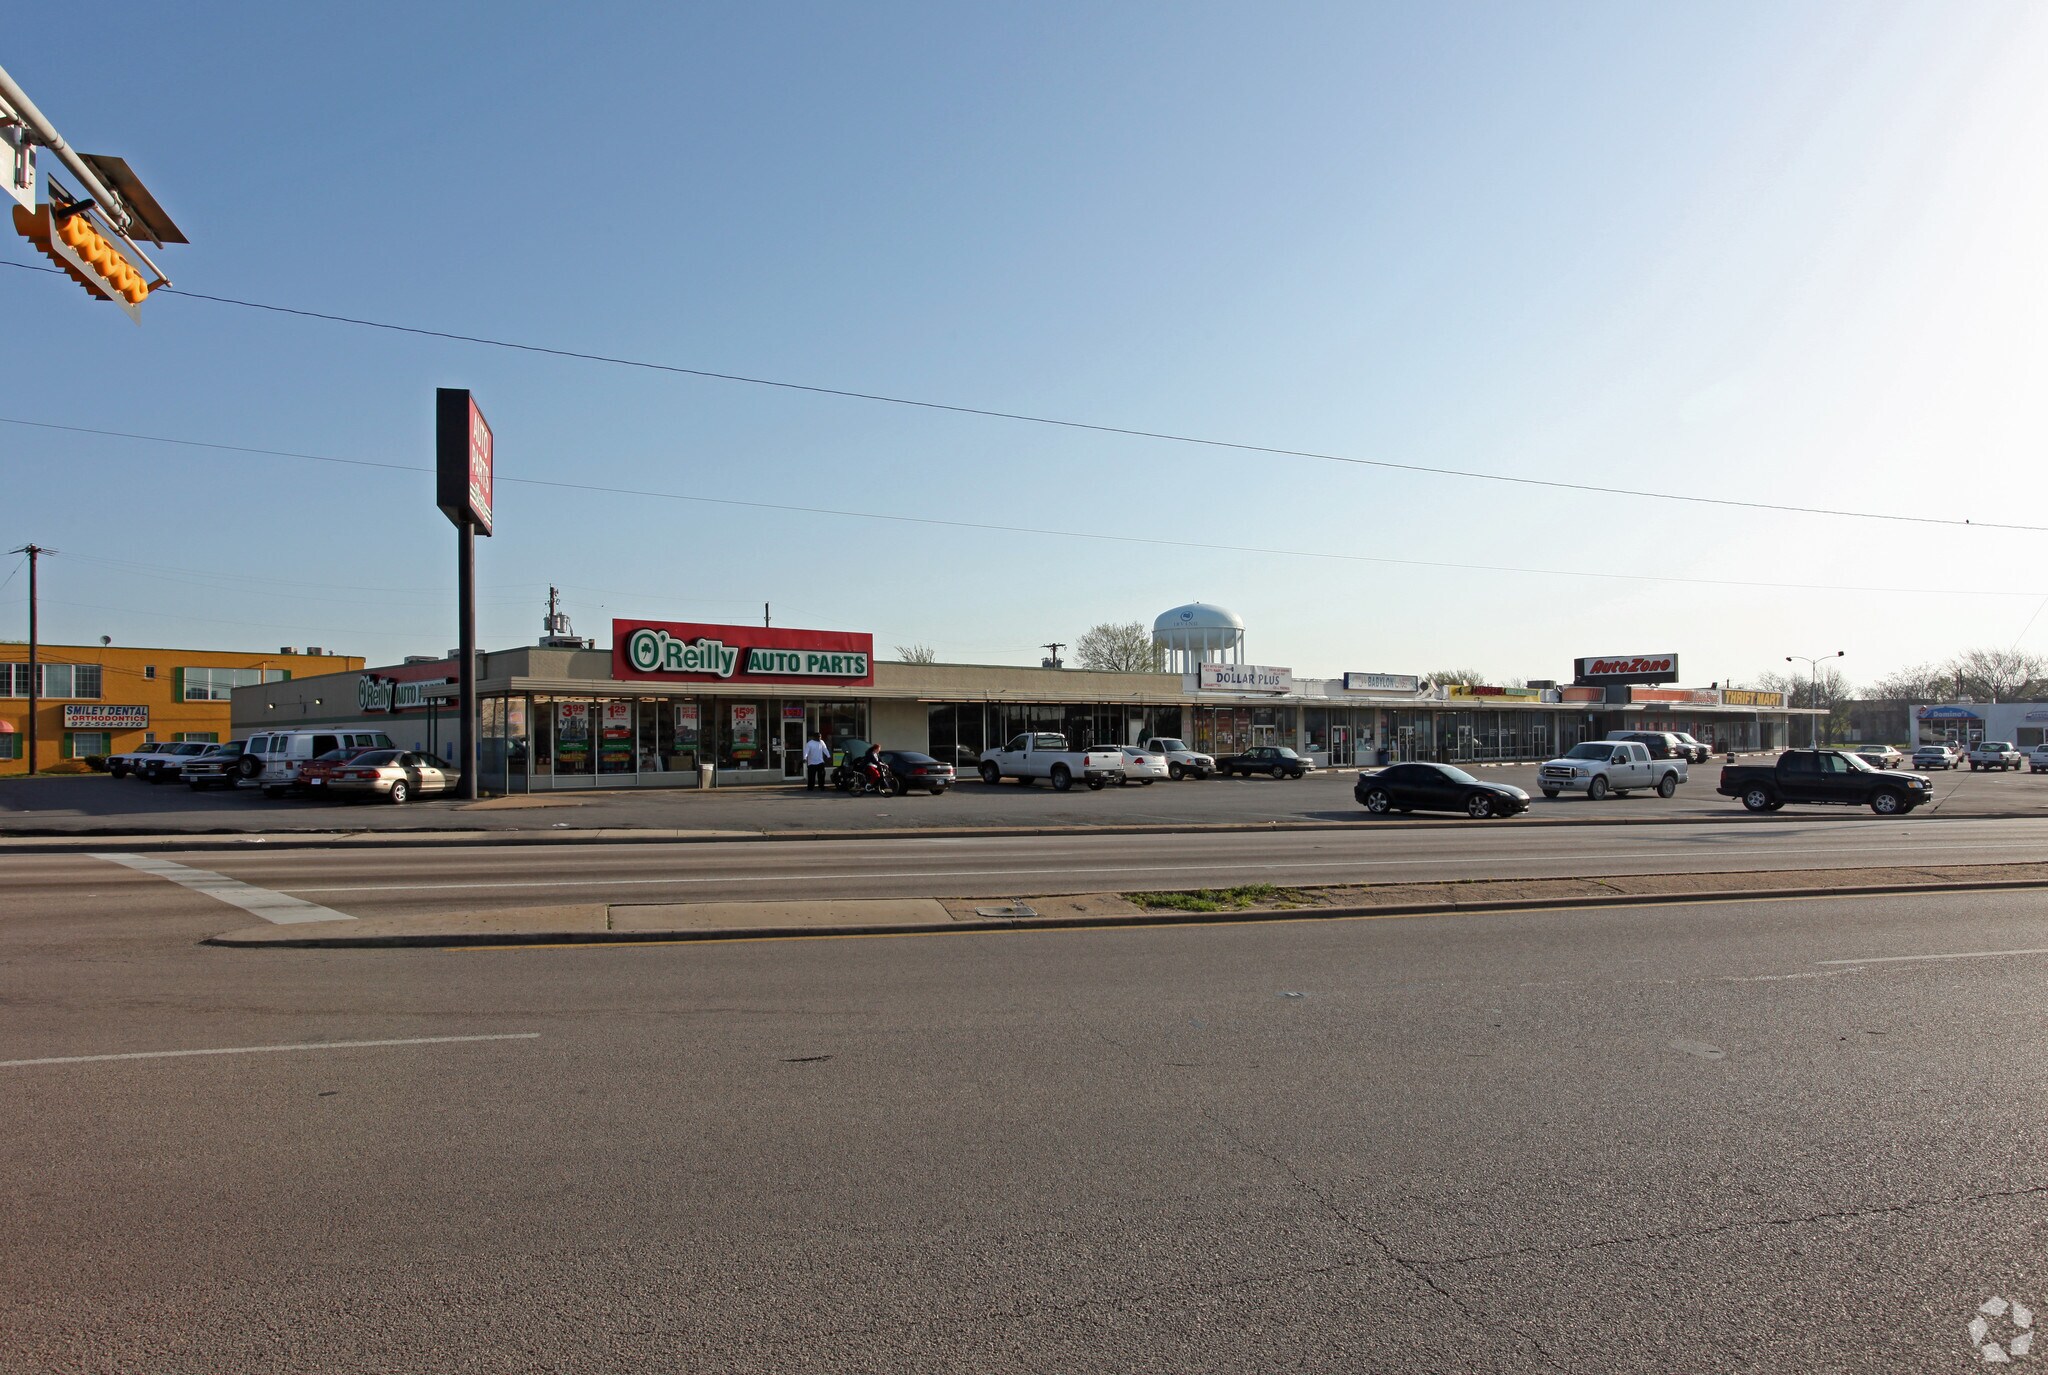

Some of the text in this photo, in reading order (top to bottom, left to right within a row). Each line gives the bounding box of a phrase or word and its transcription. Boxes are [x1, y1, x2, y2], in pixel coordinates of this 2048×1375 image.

[473, 412, 488, 459] AUTO
[472, 443, 489, 494] PARTS
[633, 633, 866, 675] O'Reilly AUTO PARTS
[1589, 658, 1671, 674] AutoZone
[1216, 672, 1280, 686] DOLLAR PLUS
[1367, 676, 1394, 688] BABYLON
[359, 678, 392, 708] O'Reilly
[395, 684, 417, 705] AUTO
[1725, 690, 1756, 705] THRIFT
[1756, 691, 1781, 706] MART
[66, 706, 147, 716] SMILEY DENTAL
